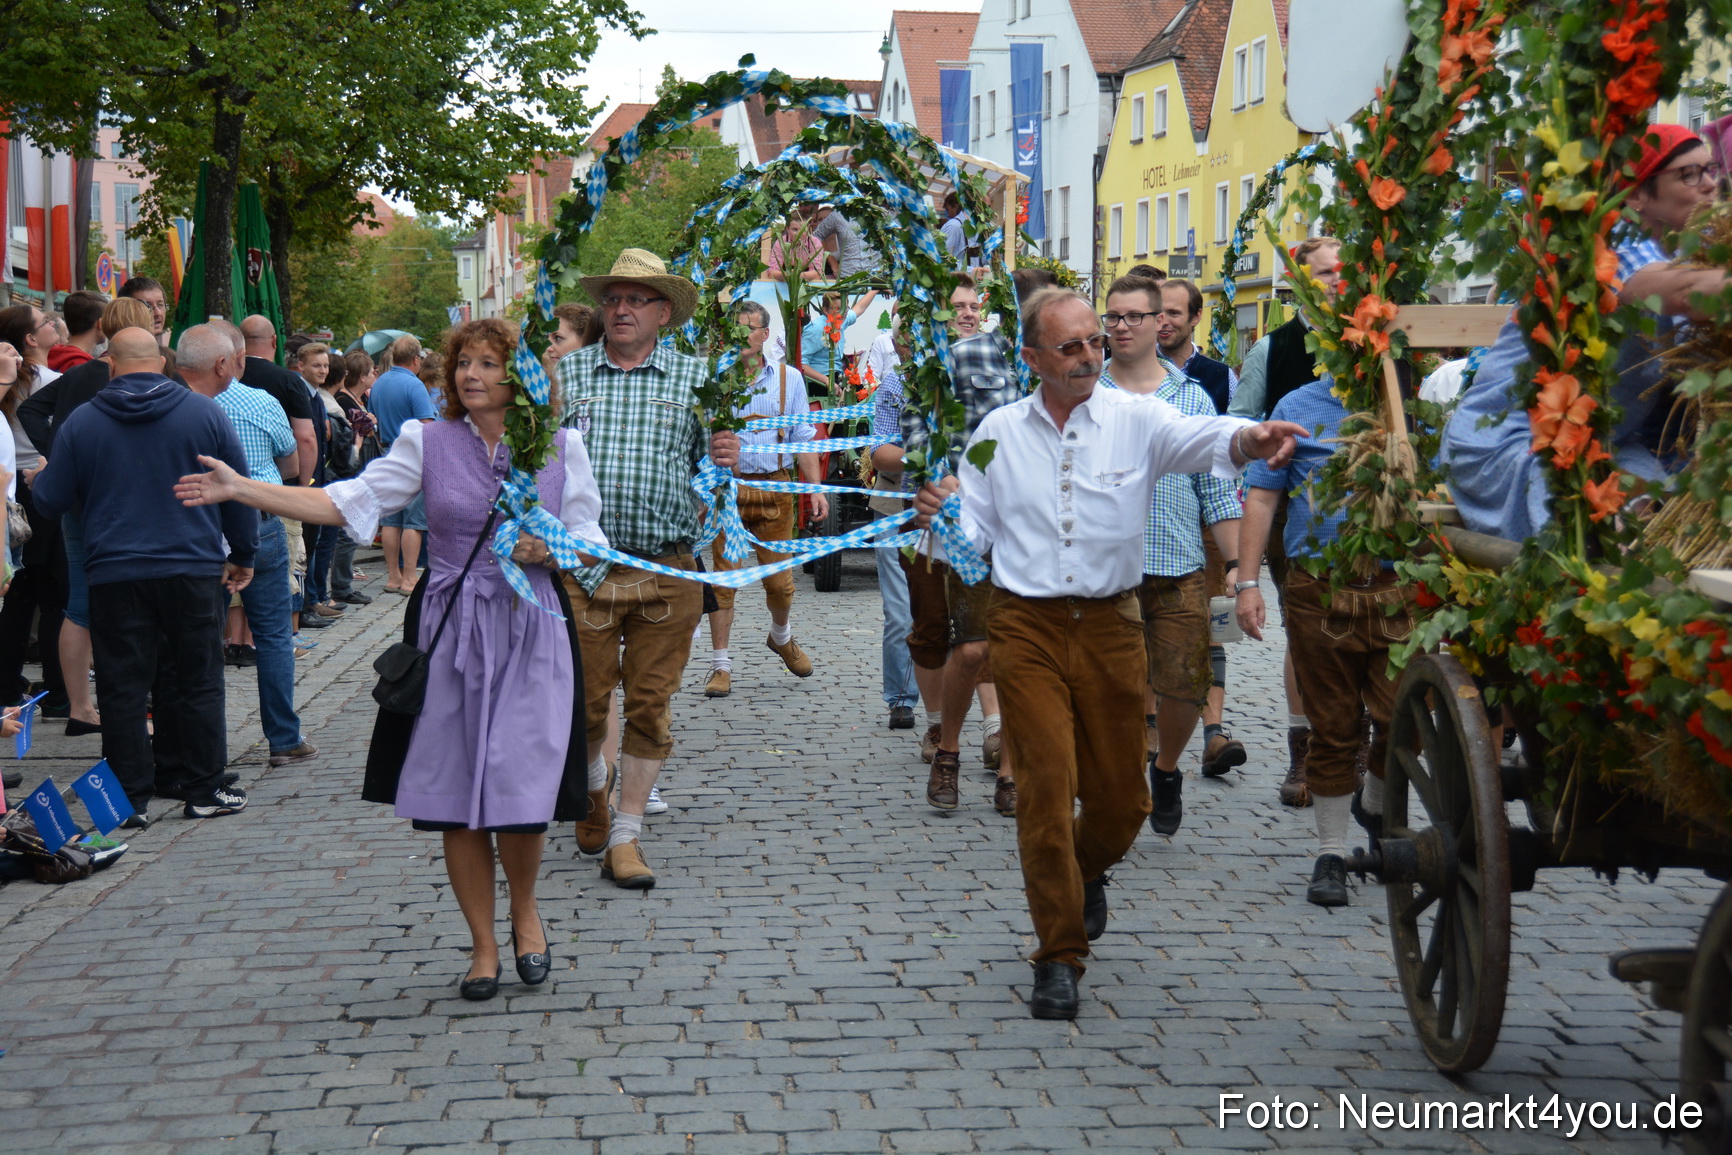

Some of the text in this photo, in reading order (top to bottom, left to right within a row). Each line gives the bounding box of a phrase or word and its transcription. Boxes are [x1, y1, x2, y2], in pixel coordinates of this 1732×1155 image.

[1018, 119, 1034, 166] K&L
[1143, 160, 1201, 190] HOTEL Lehmeier
[100, 787, 120, 822] Lebenshilfe
[48, 805, 66, 842] Lebenshilfe
